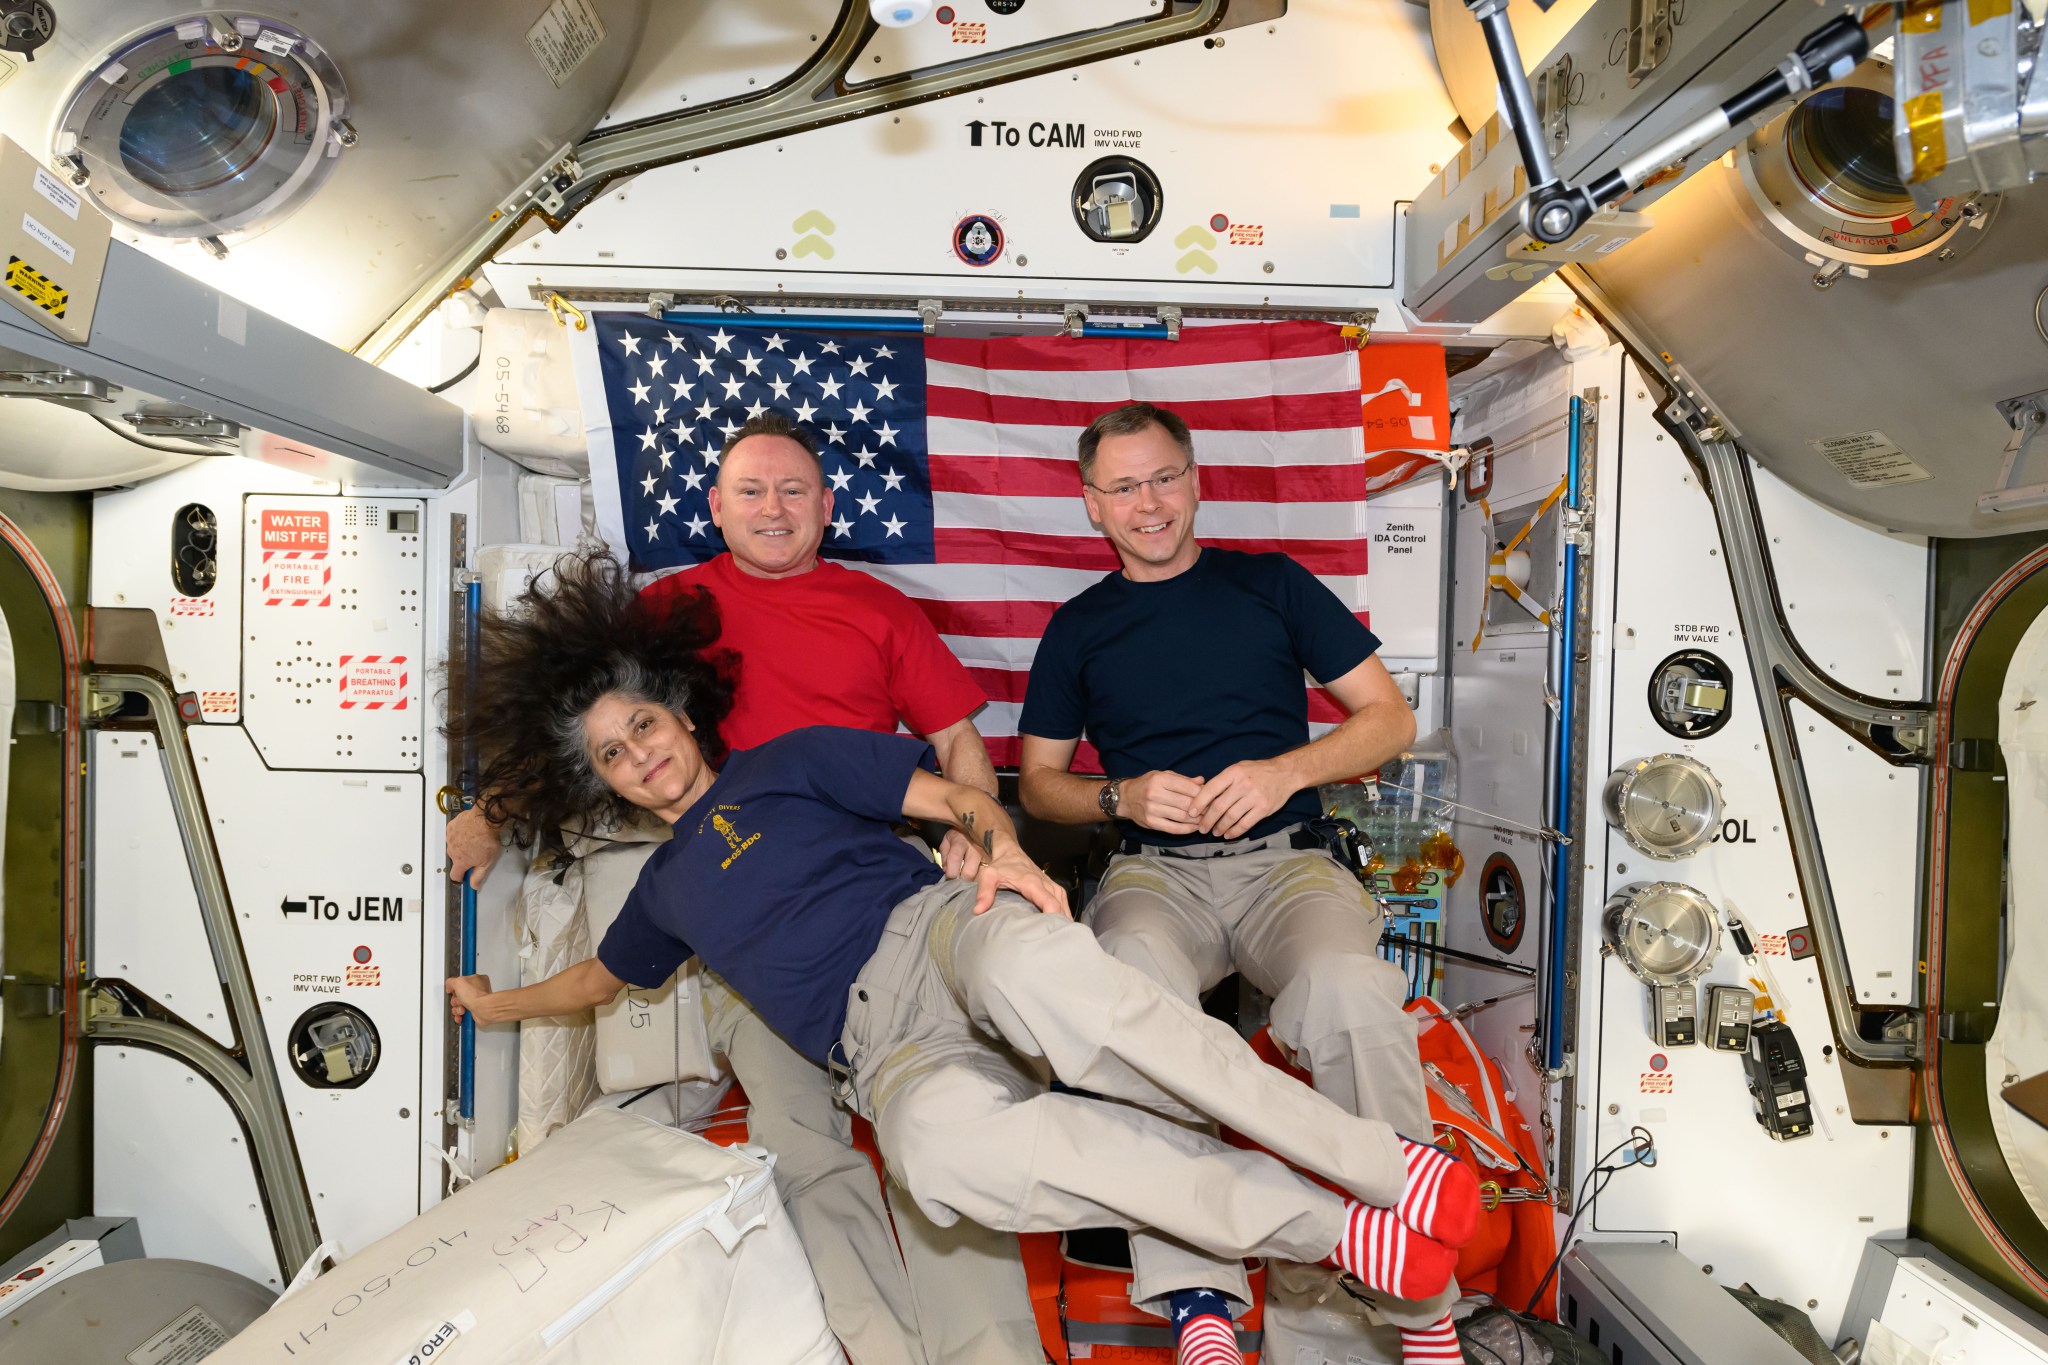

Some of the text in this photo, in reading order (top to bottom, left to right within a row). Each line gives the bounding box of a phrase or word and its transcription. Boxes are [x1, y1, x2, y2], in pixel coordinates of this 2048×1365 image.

[36, 7, 49, 32] UNLATCH
[1920, 45, 1950, 91] PFA
[992, 121, 1085, 148] To CAM
[1122, 130, 1142, 138] FWD
[25, 220, 72, 257] DO NOT MOVE
[1833, 232, 1899, 246] UNLATCHED
[19, 270, 46, 290] WARNING
[1851, 435, 1872, 445] HATCH
[271, 515, 321, 528] WATER
[264, 531, 327, 543] MIST PFE
[283, 576, 310, 584] FIRE
[351, 678, 396, 686] BREATHING
[1501, 836, 1513, 846] VALVE
[721, 832, 762, 870] 88-05-BDO
[309, 895, 403, 922] To JEM
[422, 1321, 457, 1356] ERO
